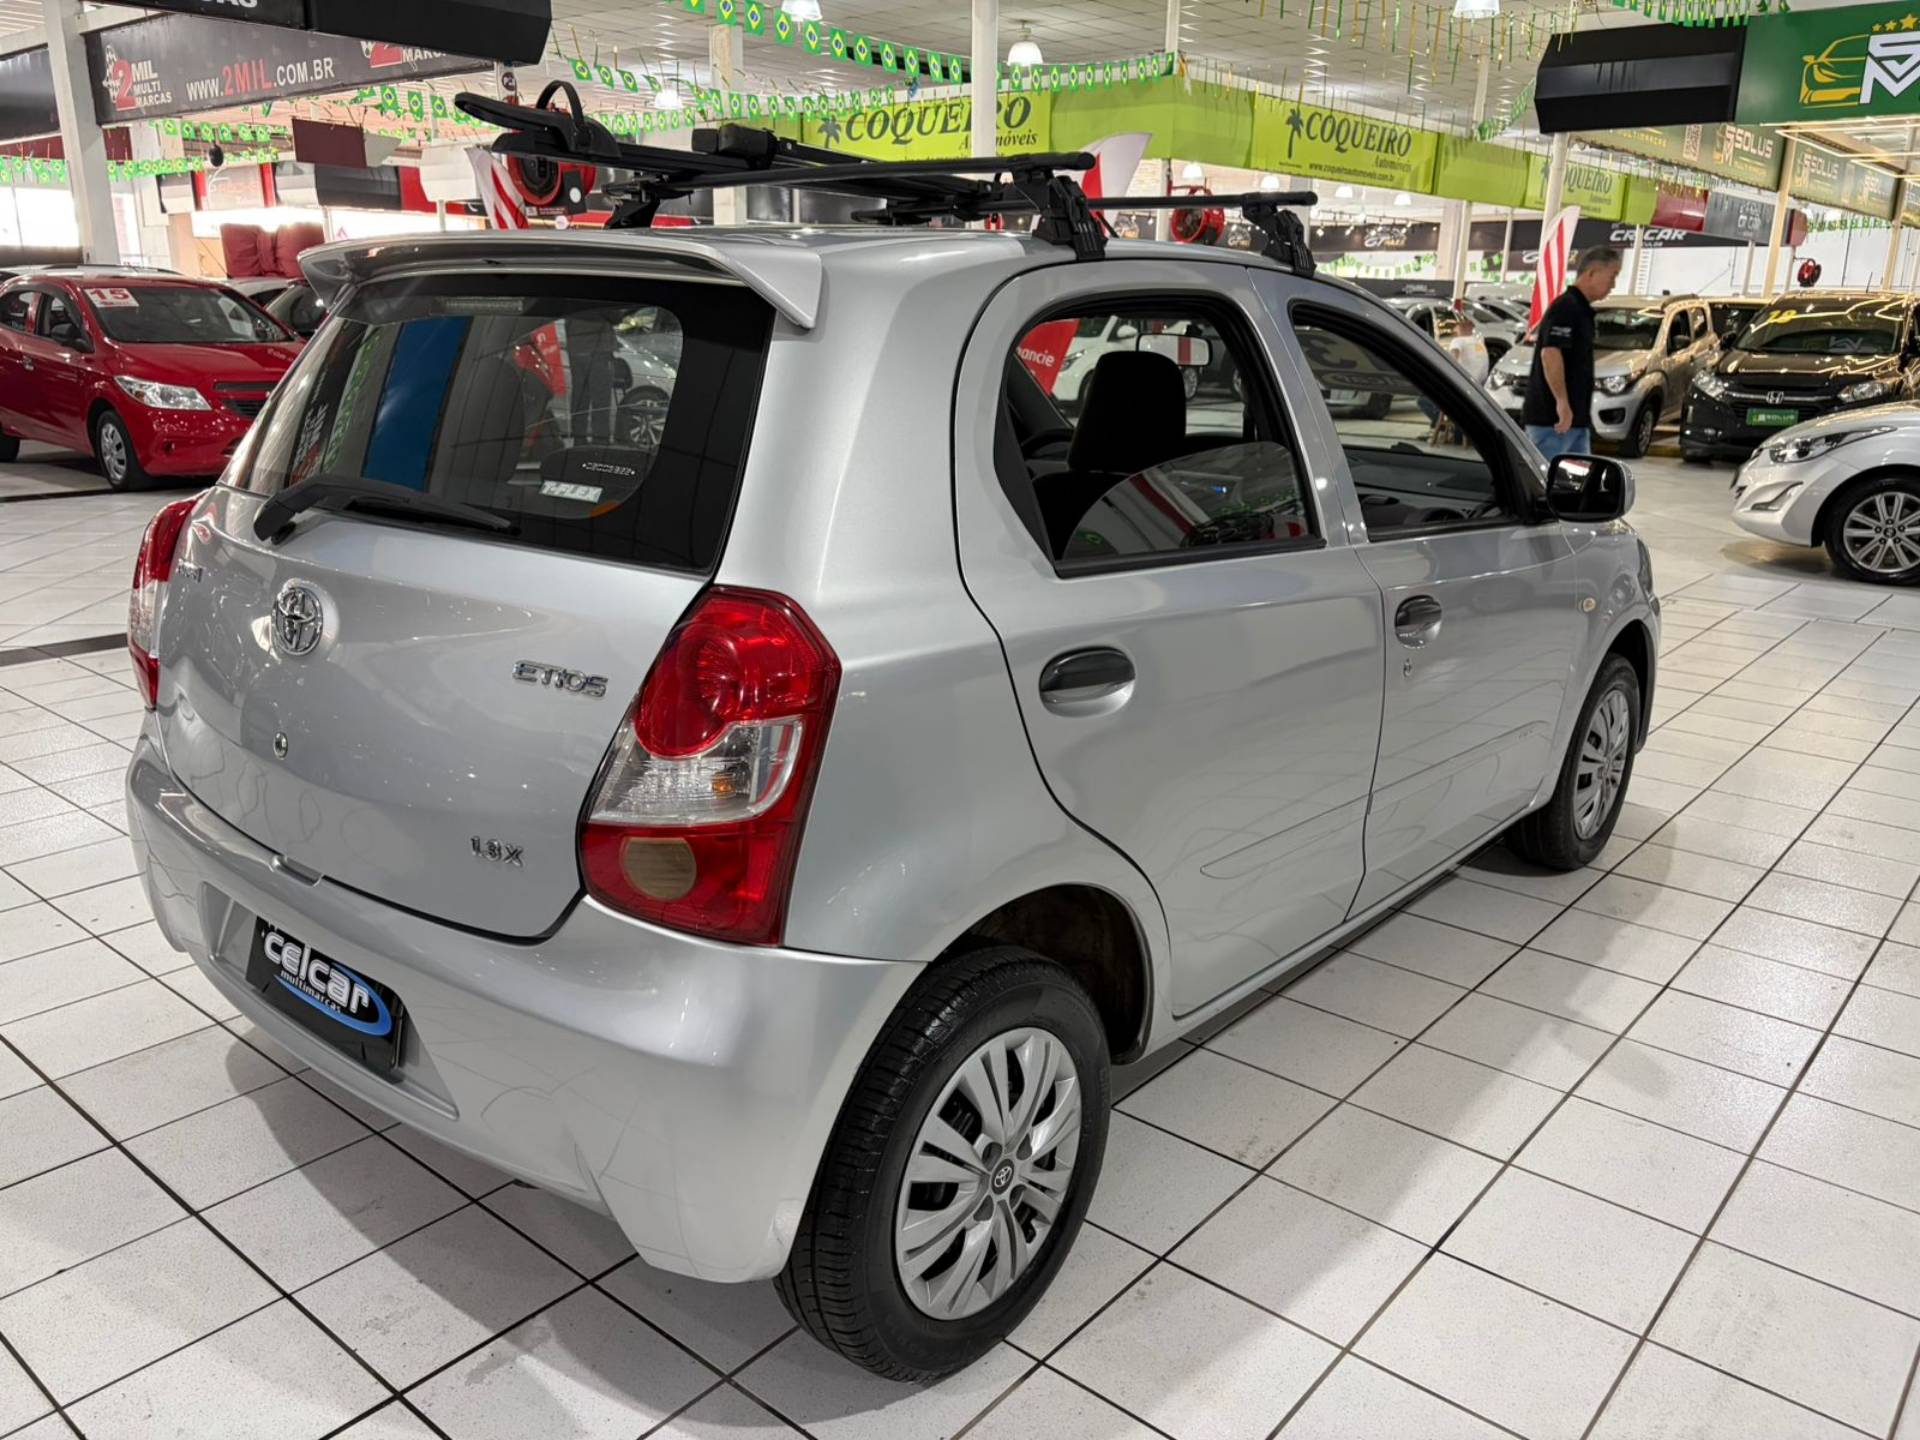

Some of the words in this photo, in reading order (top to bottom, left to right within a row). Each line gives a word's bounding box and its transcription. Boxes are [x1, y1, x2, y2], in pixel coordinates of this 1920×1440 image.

[131, 60, 159, 82] MIL
[186, 57, 335, 102] WWW.2MIL.COM.BR
[133, 80, 161, 96] MULTI
[136, 91, 173, 108] MARCAS
[845, 95, 1032, 145] COQUEIO
[1305, 111, 1412, 157] COQUEIRO
[1564, 164, 1613, 195] QUEIRO
[1643, 228, 1687, 241] CAR
[90, 288, 130, 301] 15
[263, 930, 370, 1014] celcar
